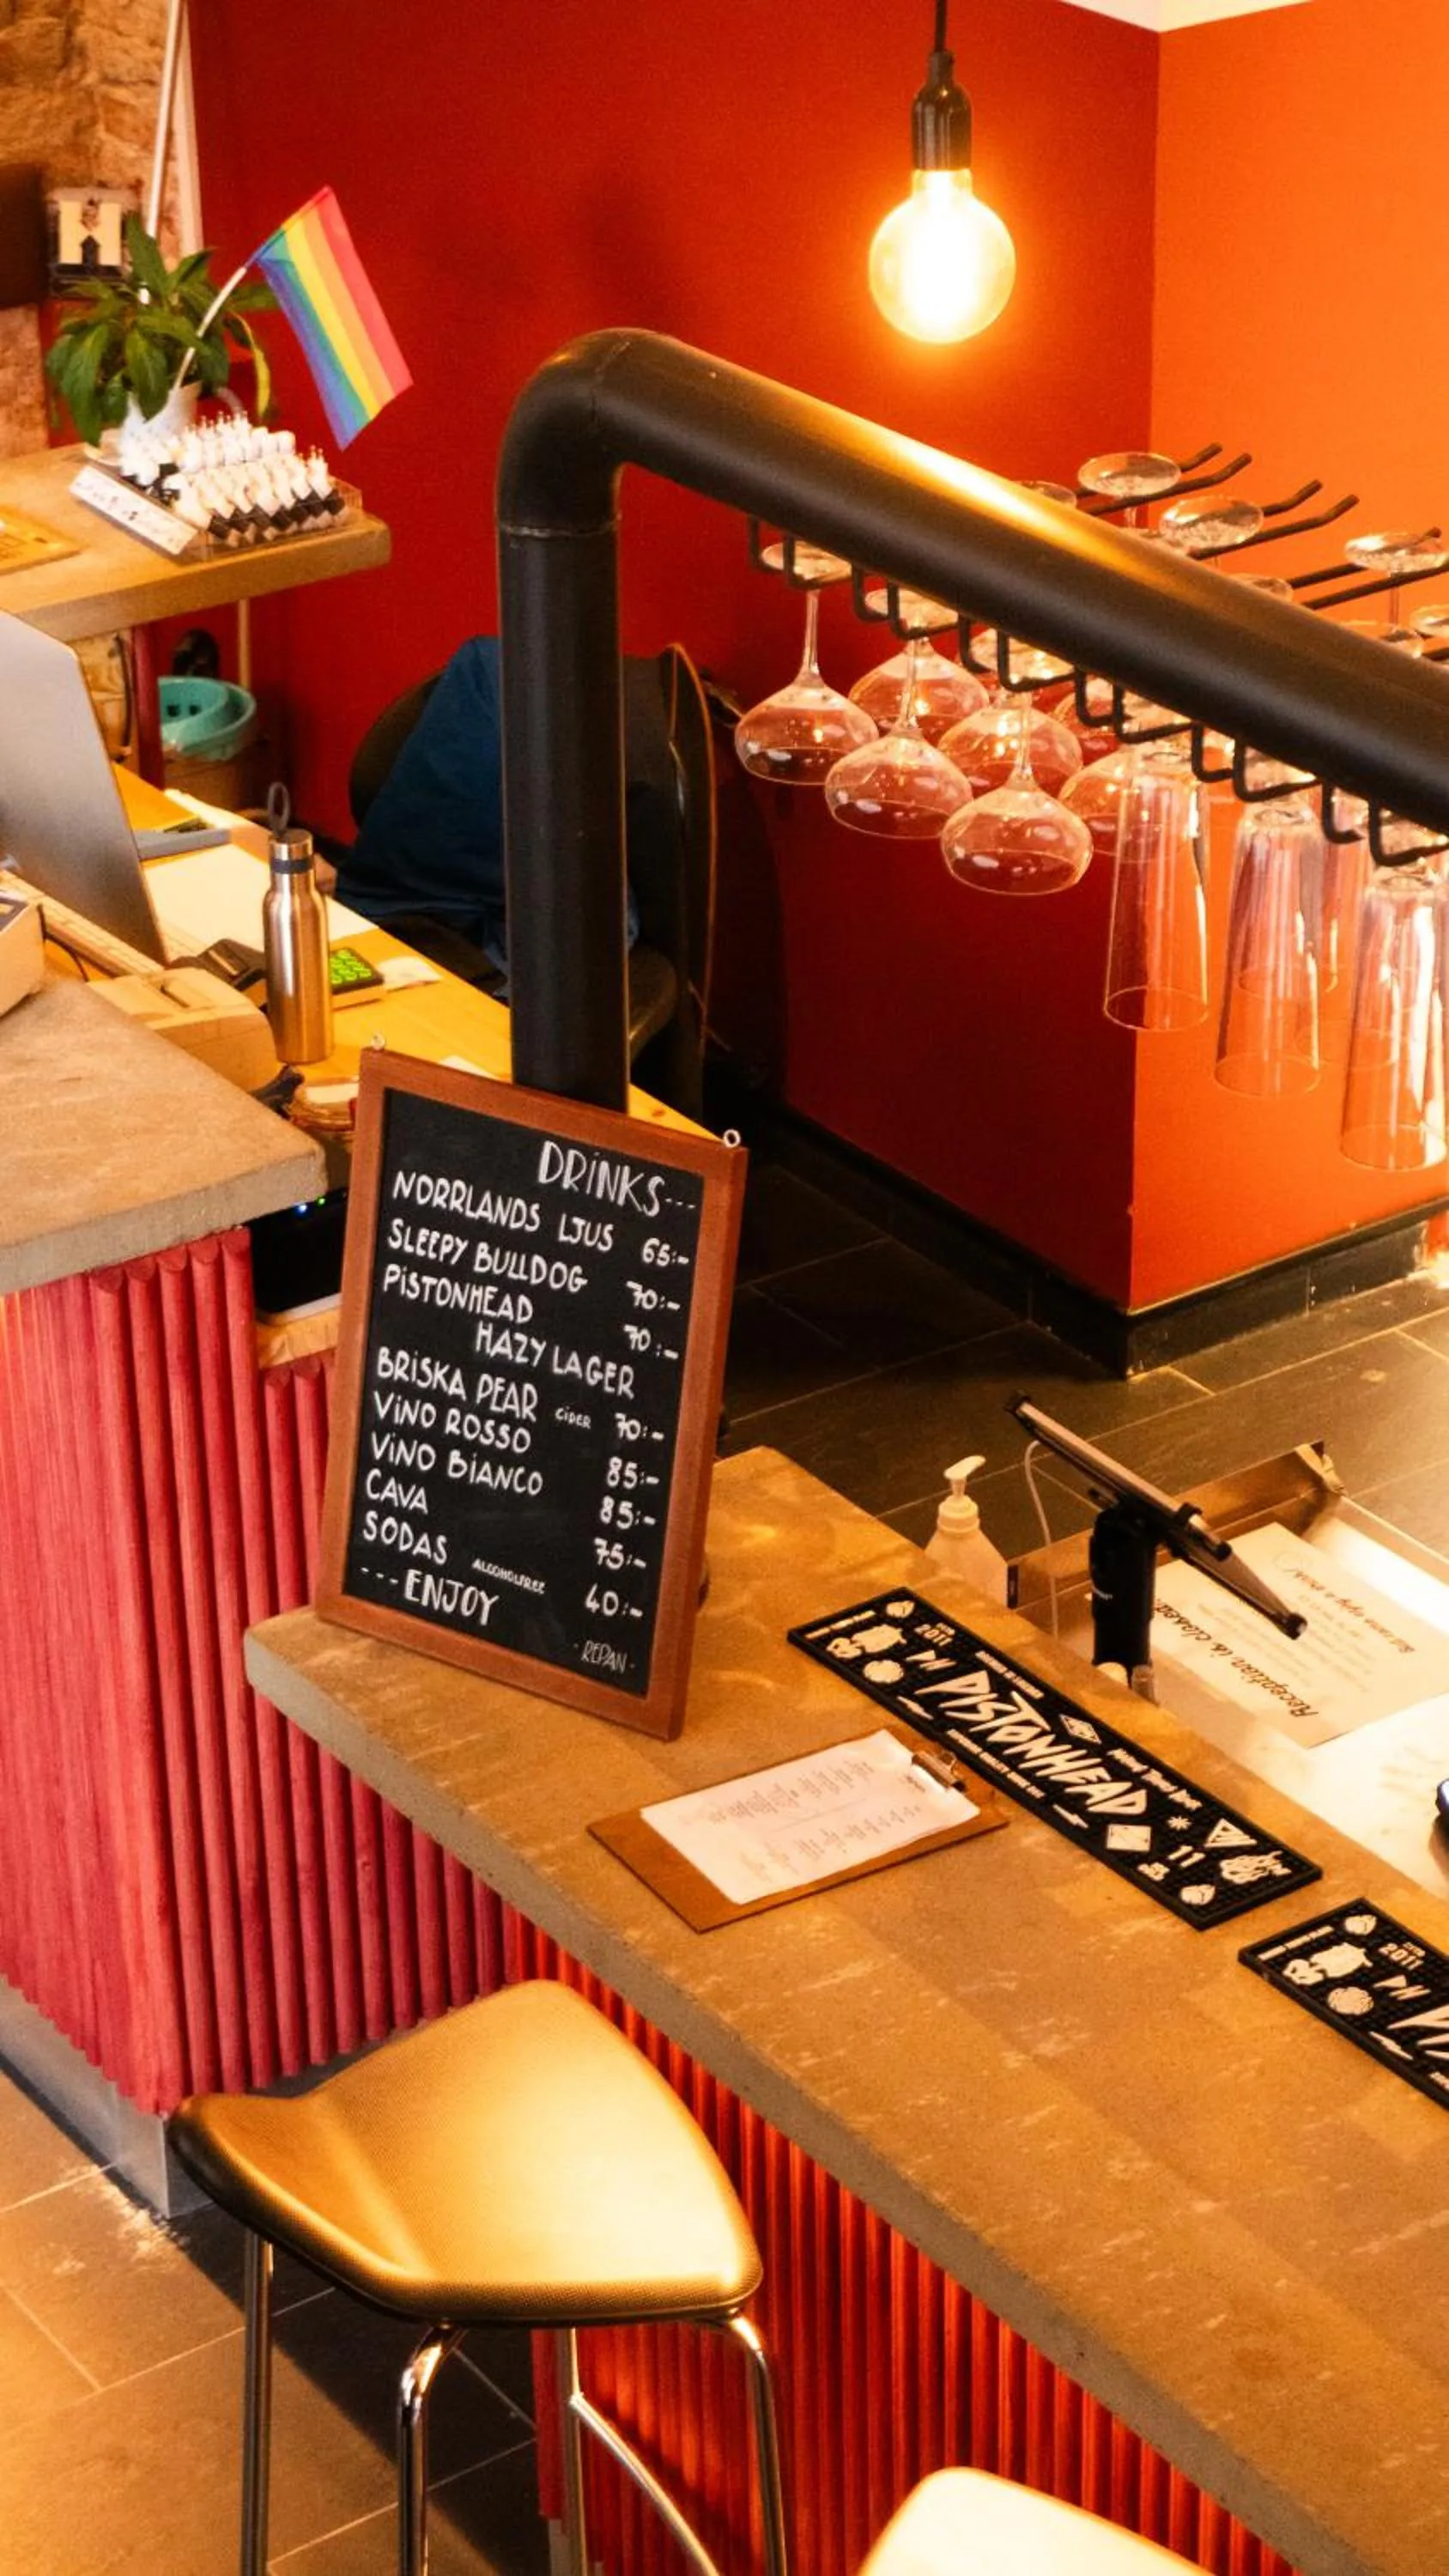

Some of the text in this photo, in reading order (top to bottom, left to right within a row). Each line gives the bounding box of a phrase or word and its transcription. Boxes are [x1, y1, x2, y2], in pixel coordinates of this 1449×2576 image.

[391, 1170, 541, 1232] NORRLANDS
[558, 1212, 614, 1252] LJUS
[387, 1218, 469, 1266] SLEEPY
[473, 1242, 589, 1294] BULLDOG
[475, 1320, 635, 1400] HAZY LAGER
[476, 1373, 539, 1423] PEAR
[445, 1408, 531, 1454] ROSSO
[366, 1468, 428, 1514] CAVA
[362, 1510, 449, 1566] SODAS
[913, 1623, 954, 1647] 2011
[1210, 1641, 1234, 1659] is
[1229, 1656, 1319, 1718] Reception
[914, 1669, 1148, 1816] PISTONHEAD
